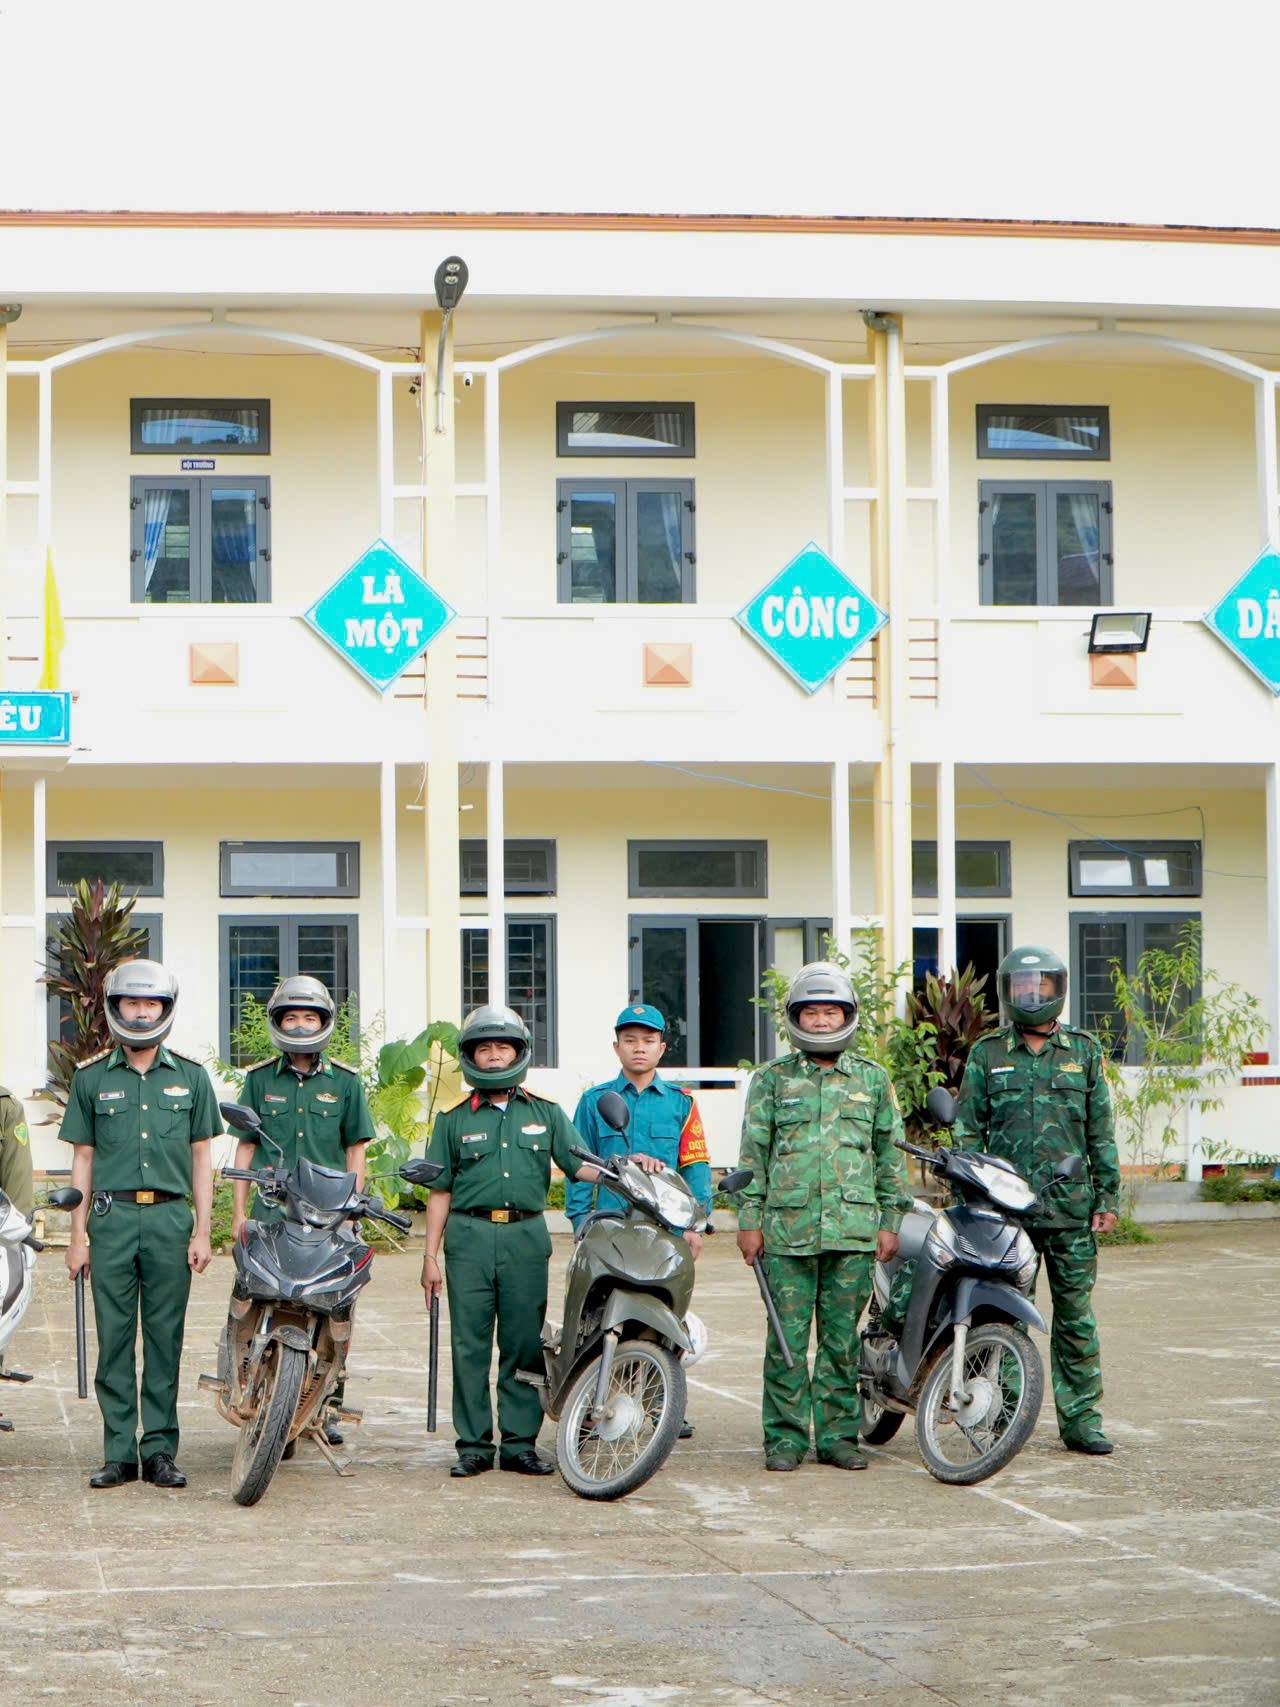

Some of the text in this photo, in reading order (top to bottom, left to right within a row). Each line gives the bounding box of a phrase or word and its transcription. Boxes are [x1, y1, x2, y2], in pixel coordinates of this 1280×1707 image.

[361, 570, 405, 604] LÀ
[344, 611, 423, 654] MỘT
[762, 586, 860, 638] CÔNG
